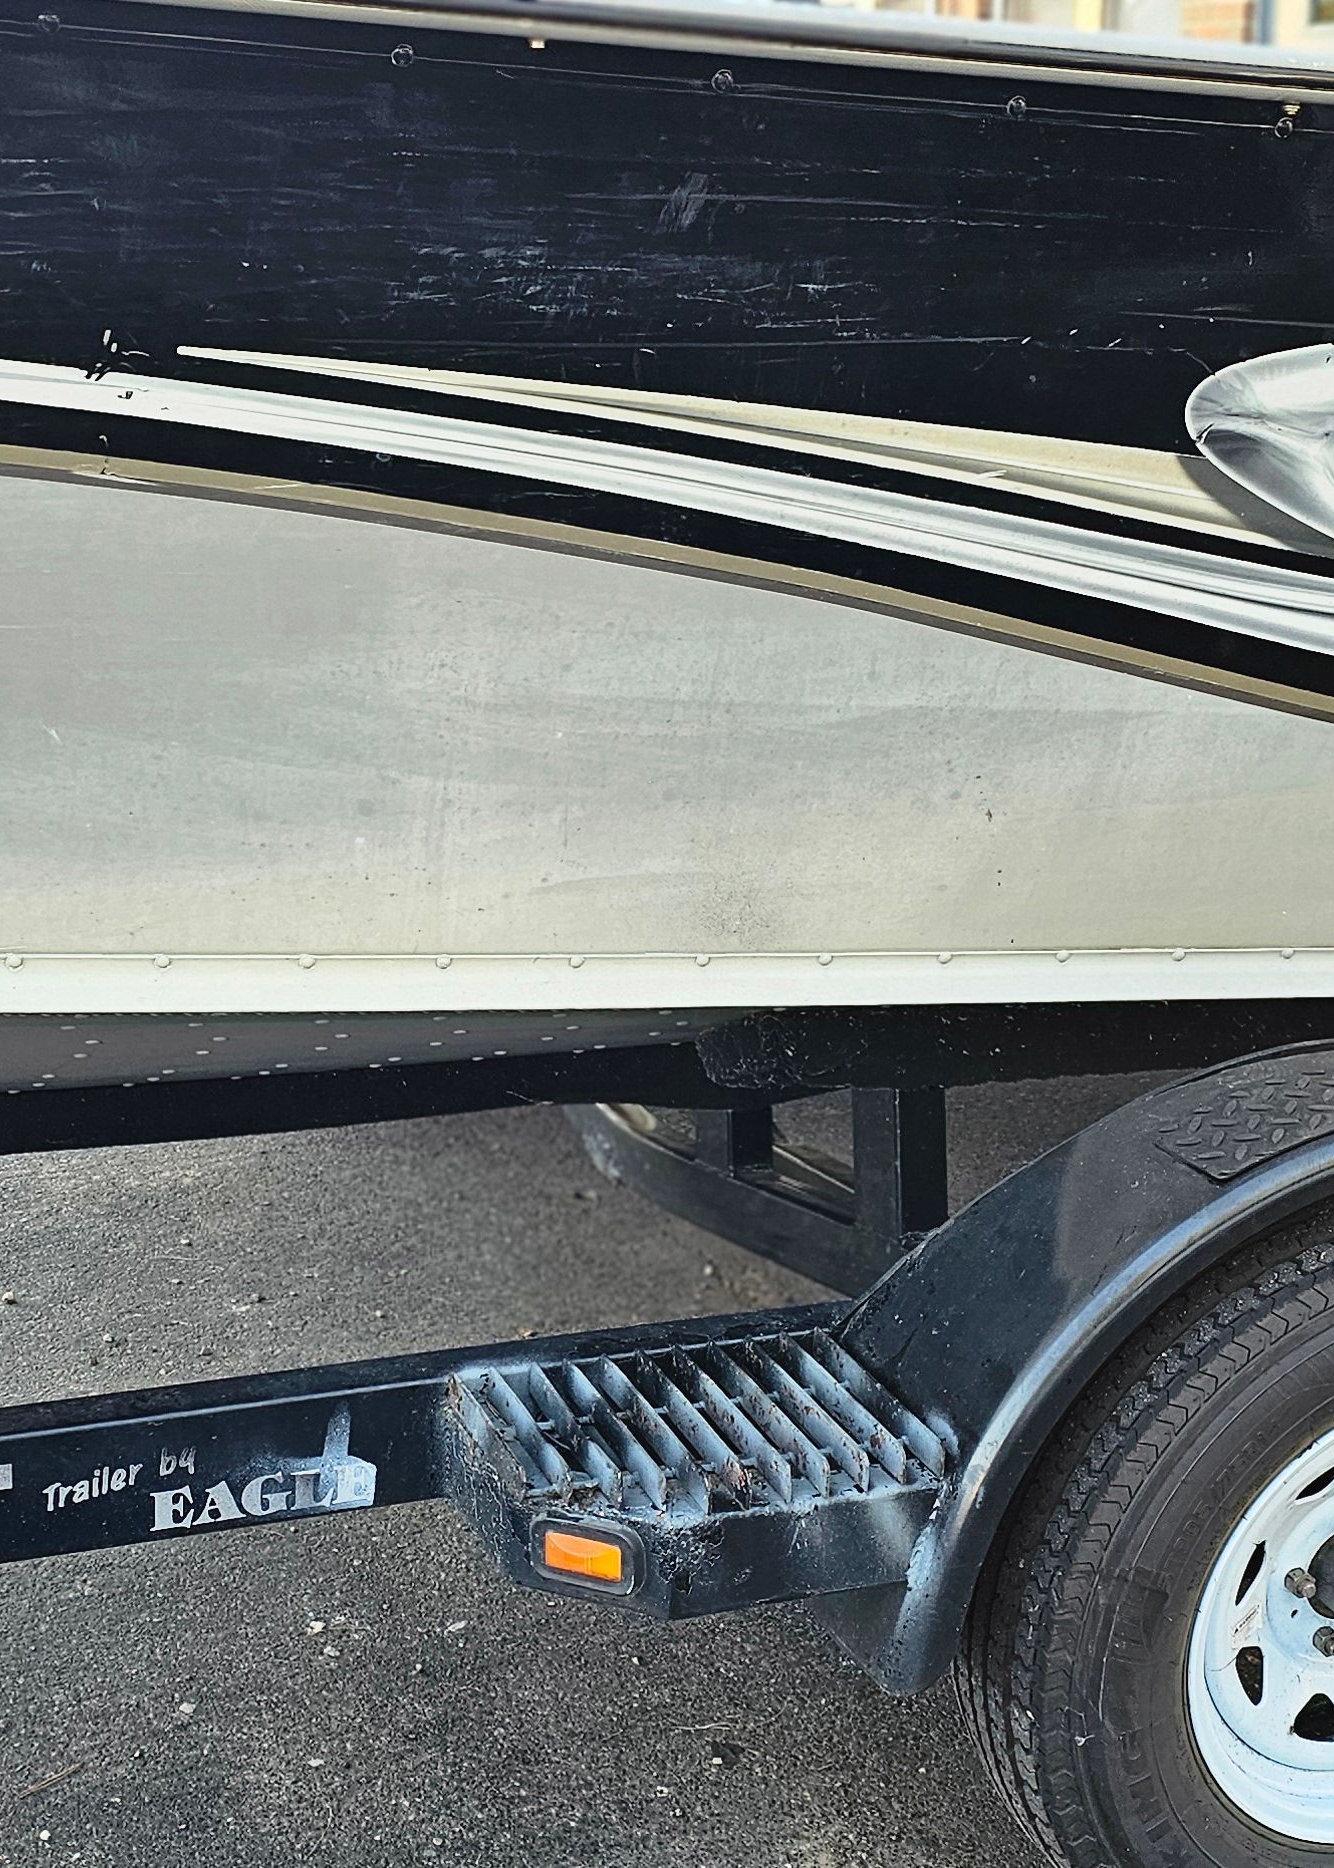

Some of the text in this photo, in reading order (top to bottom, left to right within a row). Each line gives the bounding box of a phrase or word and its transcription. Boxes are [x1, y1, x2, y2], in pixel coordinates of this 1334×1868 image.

[42, 1447, 196, 1512] Trailer by
[150, 1460, 376, 1531] EAGLE
